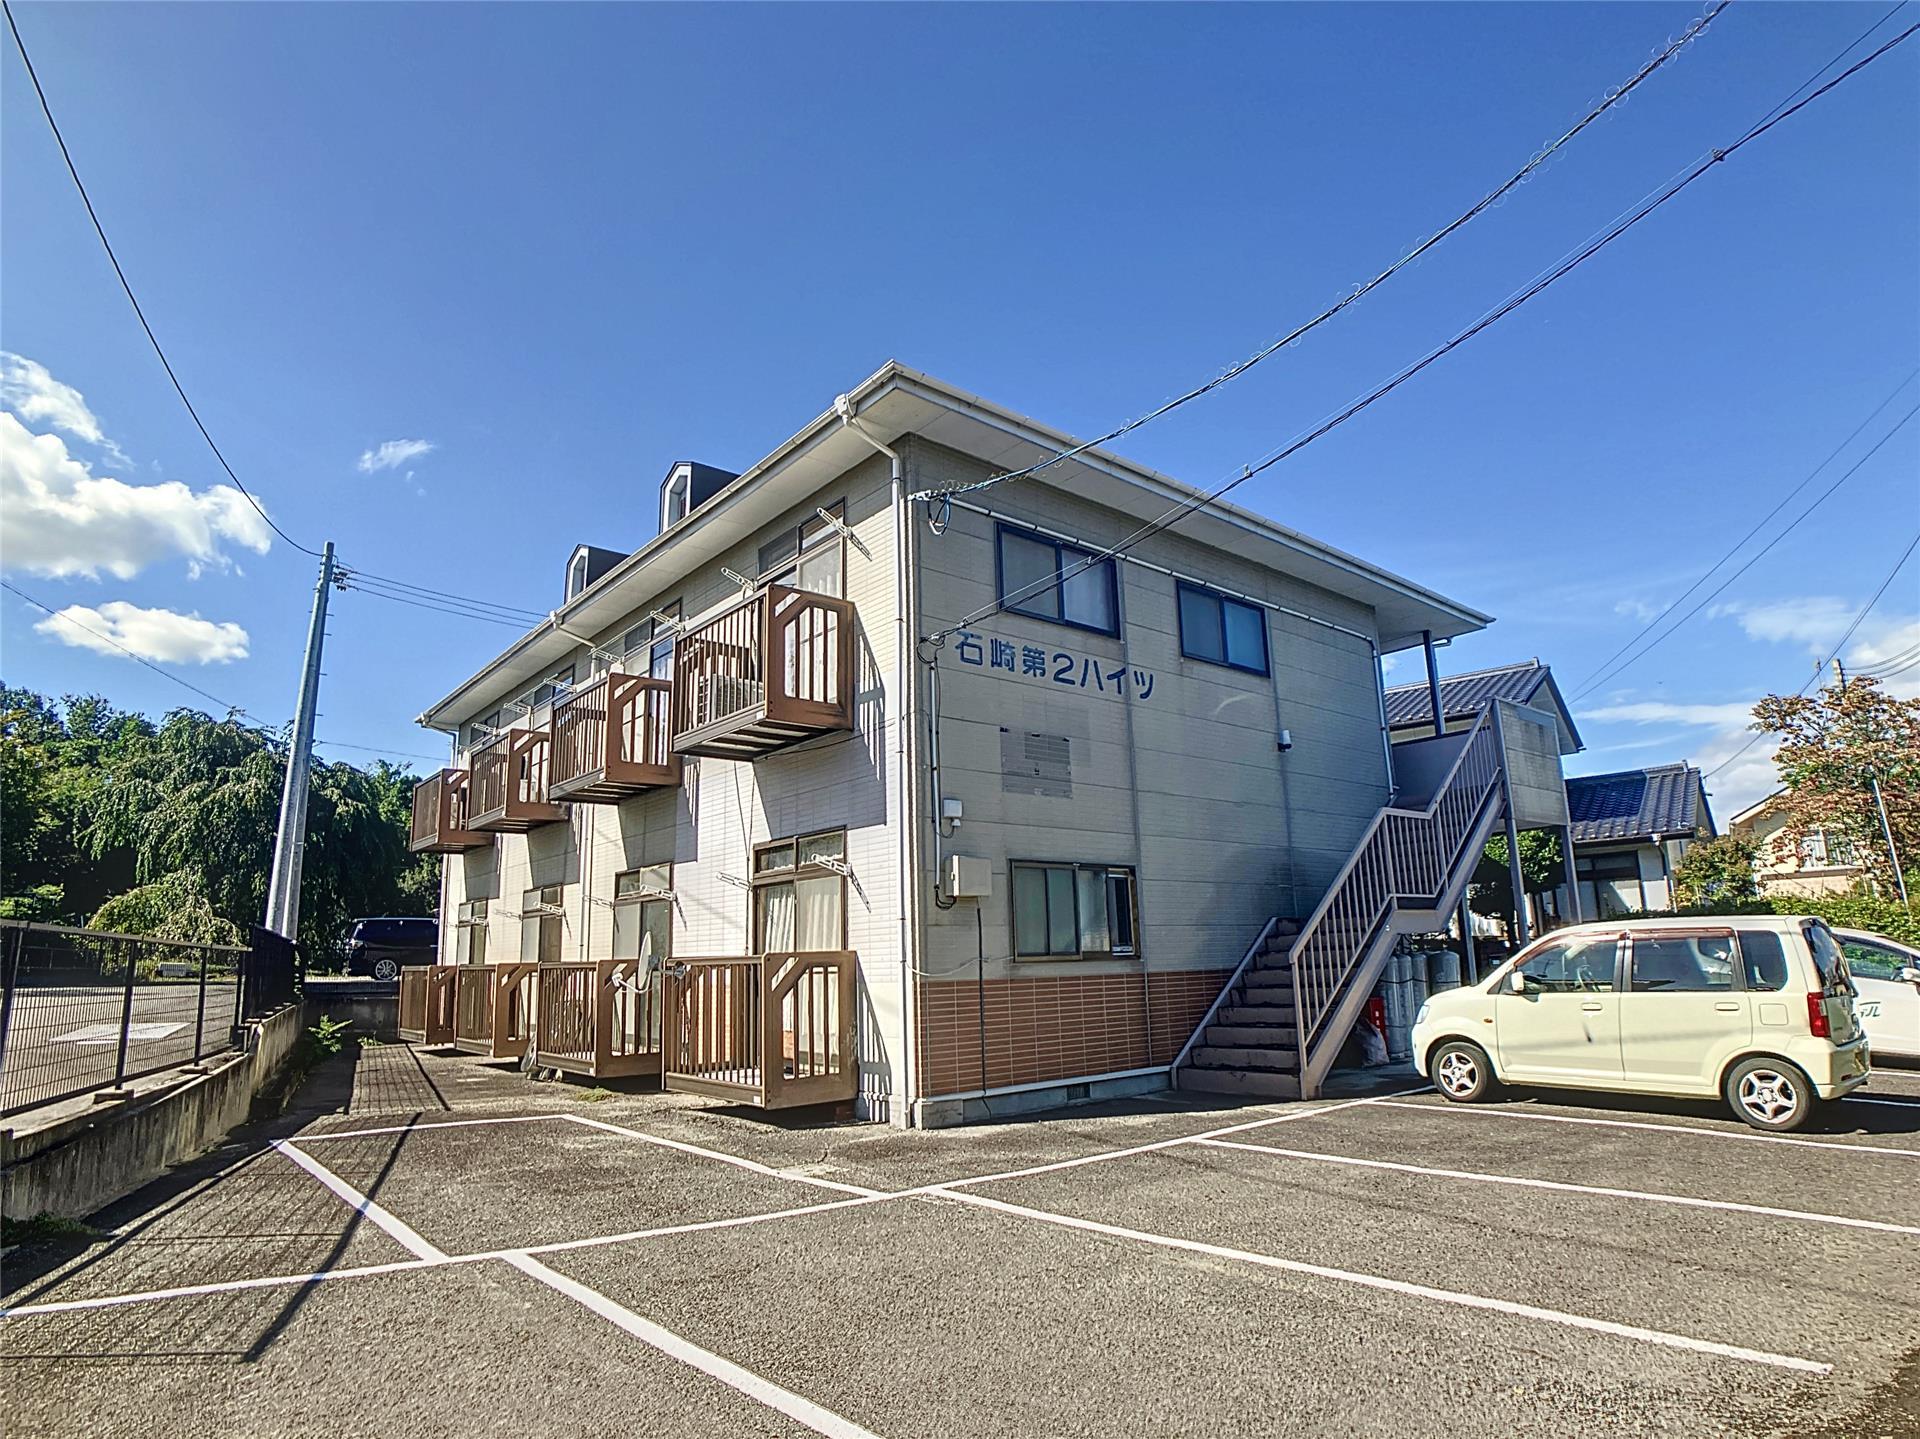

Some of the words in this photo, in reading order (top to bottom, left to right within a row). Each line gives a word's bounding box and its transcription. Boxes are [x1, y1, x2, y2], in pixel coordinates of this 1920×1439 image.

[954, 630, 1154, 700] 石崎第2ハイツ
